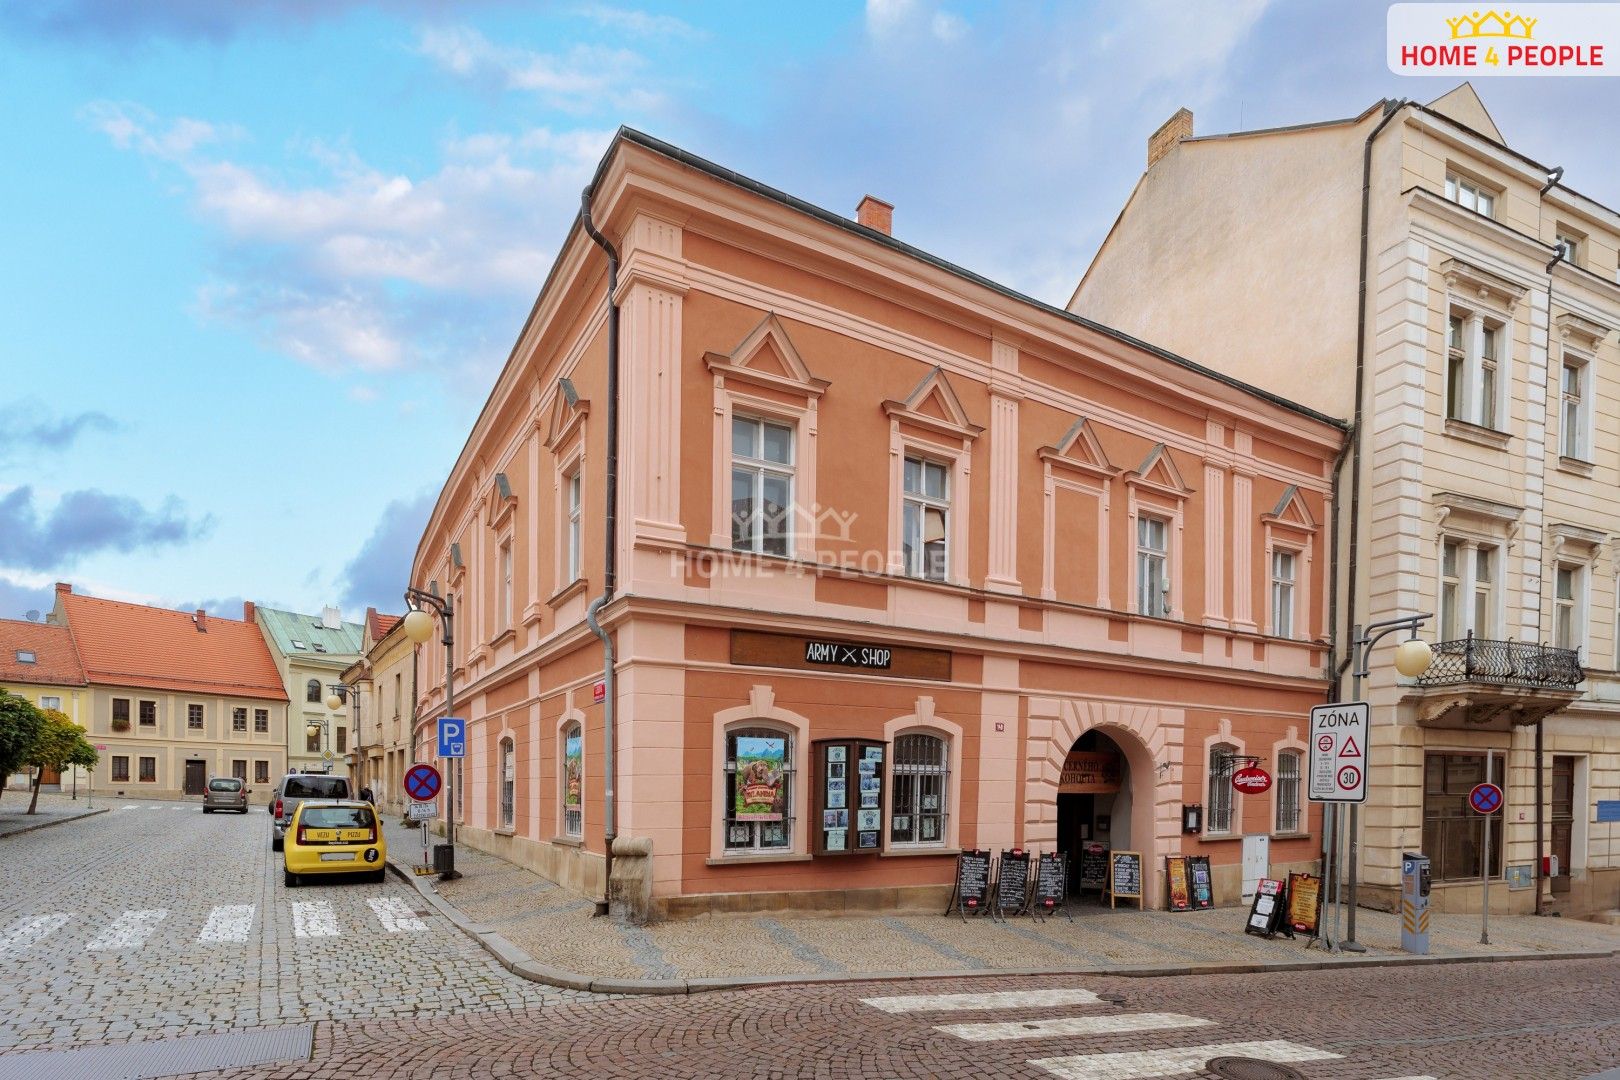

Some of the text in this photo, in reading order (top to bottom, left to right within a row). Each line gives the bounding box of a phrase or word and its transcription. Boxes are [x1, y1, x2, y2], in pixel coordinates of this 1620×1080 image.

[806, 643, 890, 666] ARMY SHOP
[1318, 710, 1360, 728] ZÓNA
[443, 723, 459, 746] P
[1343, 772, 1355, 784] 30
[1404, 862, 1412, 872] P
